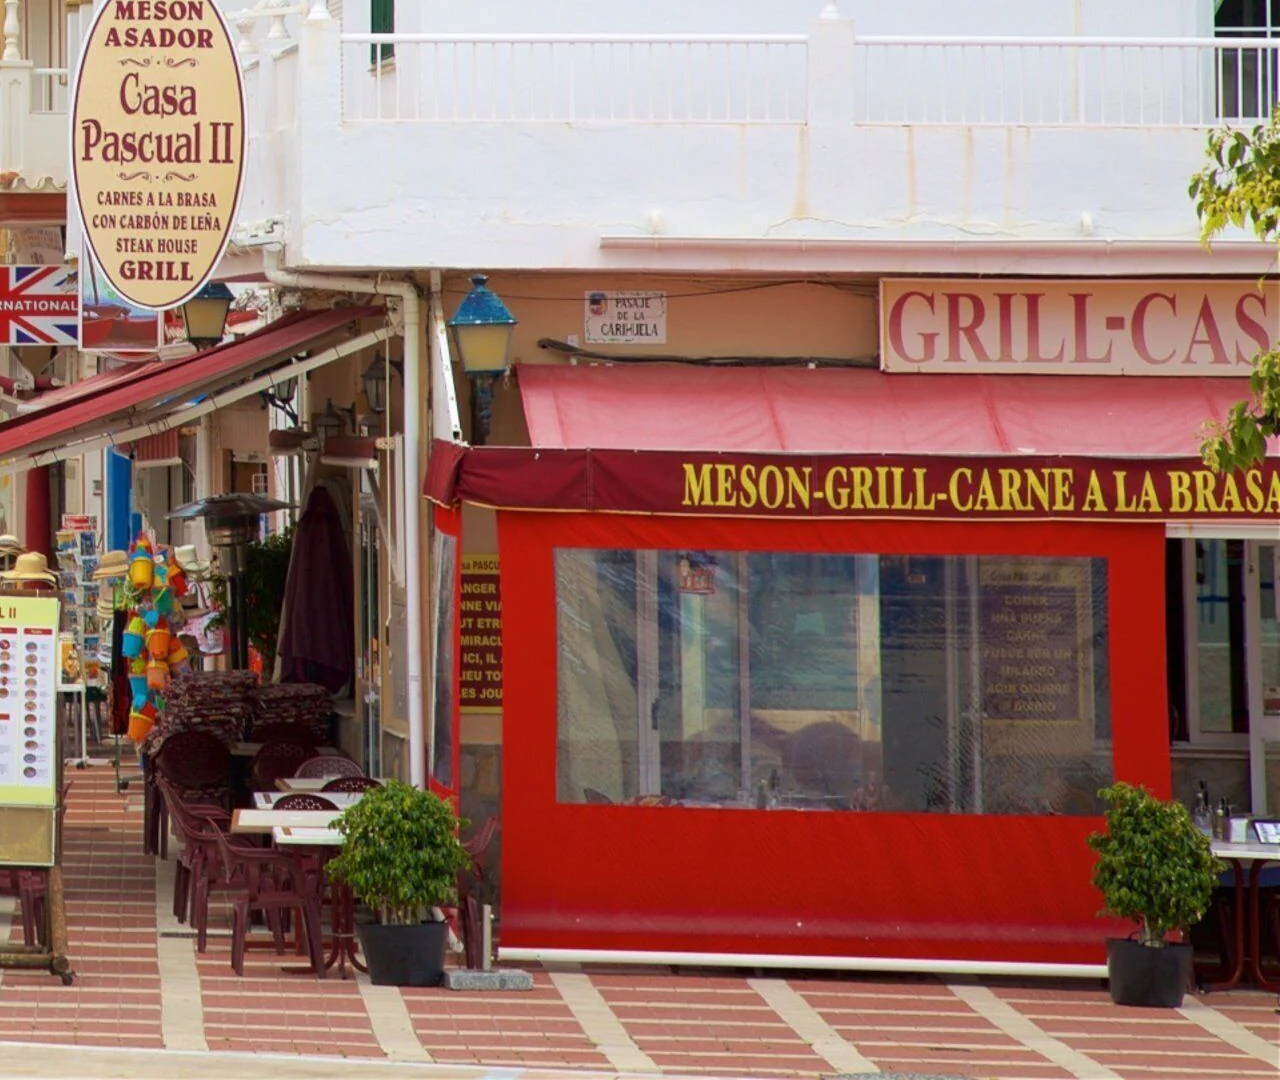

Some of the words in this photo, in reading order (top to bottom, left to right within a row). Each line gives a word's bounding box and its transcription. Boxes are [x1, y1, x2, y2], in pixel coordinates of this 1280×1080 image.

[104, 28, 213, 48] ASADOR
[119, 72, 197, 119] Casa
[81, 119, 201, 166] Pascual
[209, 122, 233, 164] II
[97, 191, 143, 206] CARNES
[146, 192, 154, 206] A
[158, 192, 173, 206] LA
[176, 192, 217, 207] BRASA
[92, 214, 117, 229] CON
[119, 211, 169, 230] CARBÓN
[172, 215, 188, 230] DE
[190, 211, 221, 231] LEÑA
[116, 238, 153, 253] STEAK
[157, 239, 198, 254] HOUSE
[119, 261, 194, 281] GRILL
[615, 297, 651, 308] PASAJE
[617, 311, 628, 321] DE
[634, 311, 645, 321] LA
[600, 323, 658, 336] CARIHUELA
[888, 291, 1271, 366] GRILL-CAS
[682, 462, 1075, 512] MESON-GRILL-CARNE
[1082, 468, 1108, 512] A
[1112, 470, 1163, 513] LA
[9, 607, 16, 618] II
[477, 618, 502, 629] ETR
